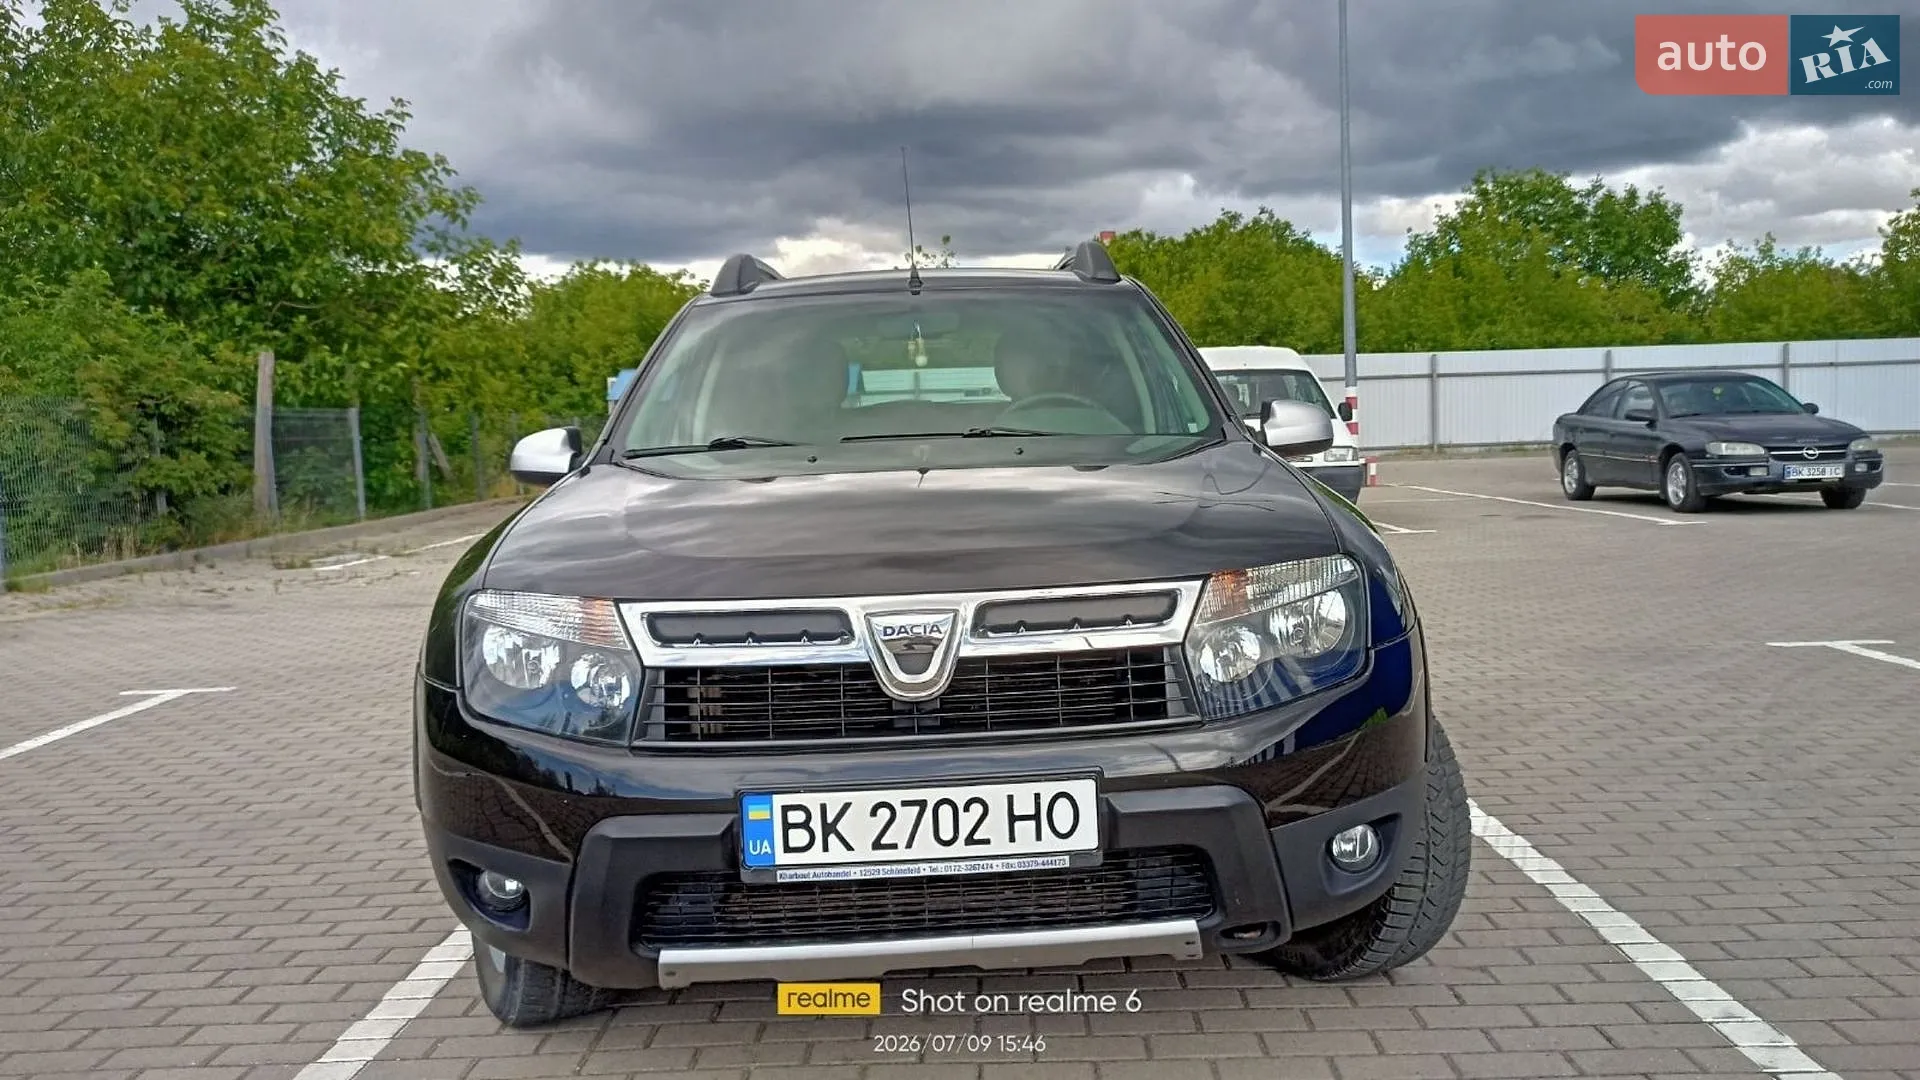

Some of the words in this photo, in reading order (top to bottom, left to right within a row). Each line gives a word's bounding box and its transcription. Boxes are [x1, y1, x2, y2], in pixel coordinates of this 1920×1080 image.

[882, 624, 942, 637] DACIA
[781, 802, 854, 854] BK
[869, 796, 991, 851] 2702
[1006, 791, 1080, 843] HO
[749, 839, 771, 855] UA
